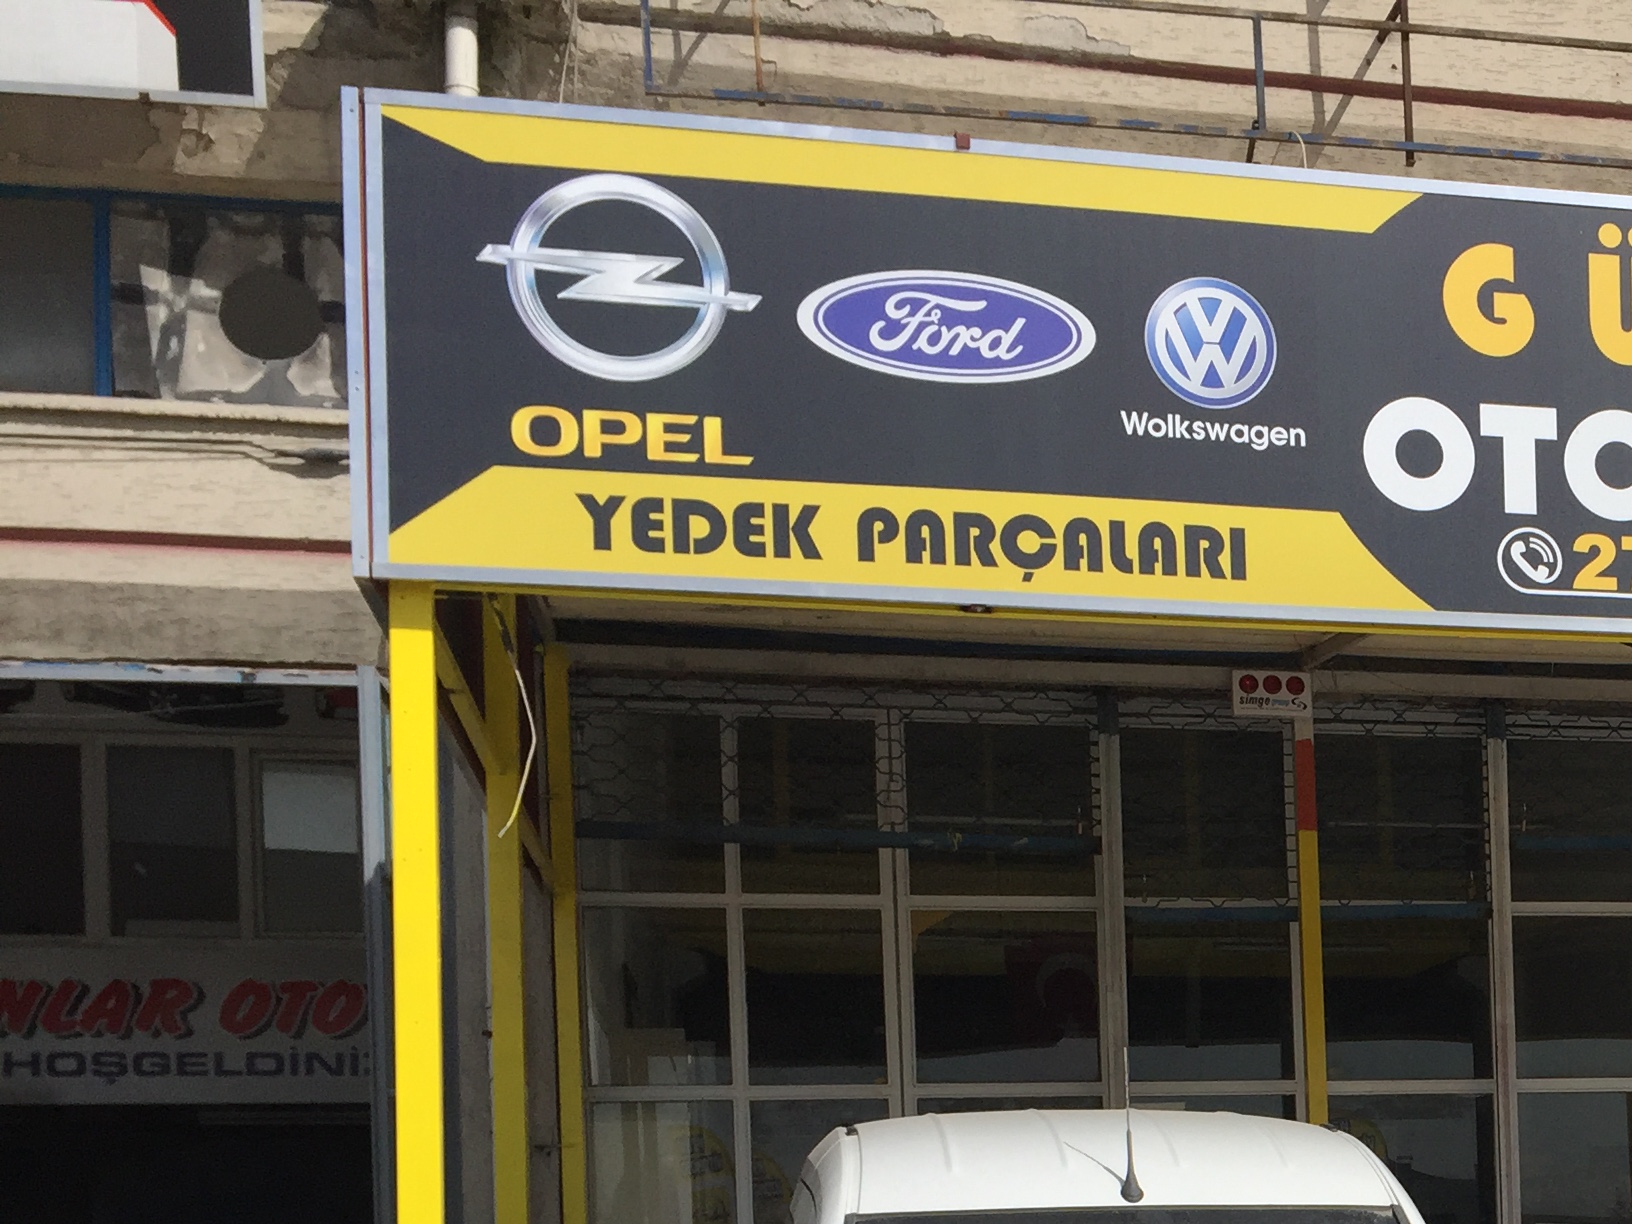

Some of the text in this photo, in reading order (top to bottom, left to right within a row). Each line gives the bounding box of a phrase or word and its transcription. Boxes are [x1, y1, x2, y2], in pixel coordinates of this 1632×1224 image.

[869, 290, 1027, 361] Ford
[509, 405, 755, 466] OPEL
[1120, 410, 1306, 451] Wolkswagen
[575, 493, 1248, 583] YEDEK PARÇALARI
[218, 977, 368, 1040] OTO
[3, 1046, 371, 1086] HOŞGELDİNİ
